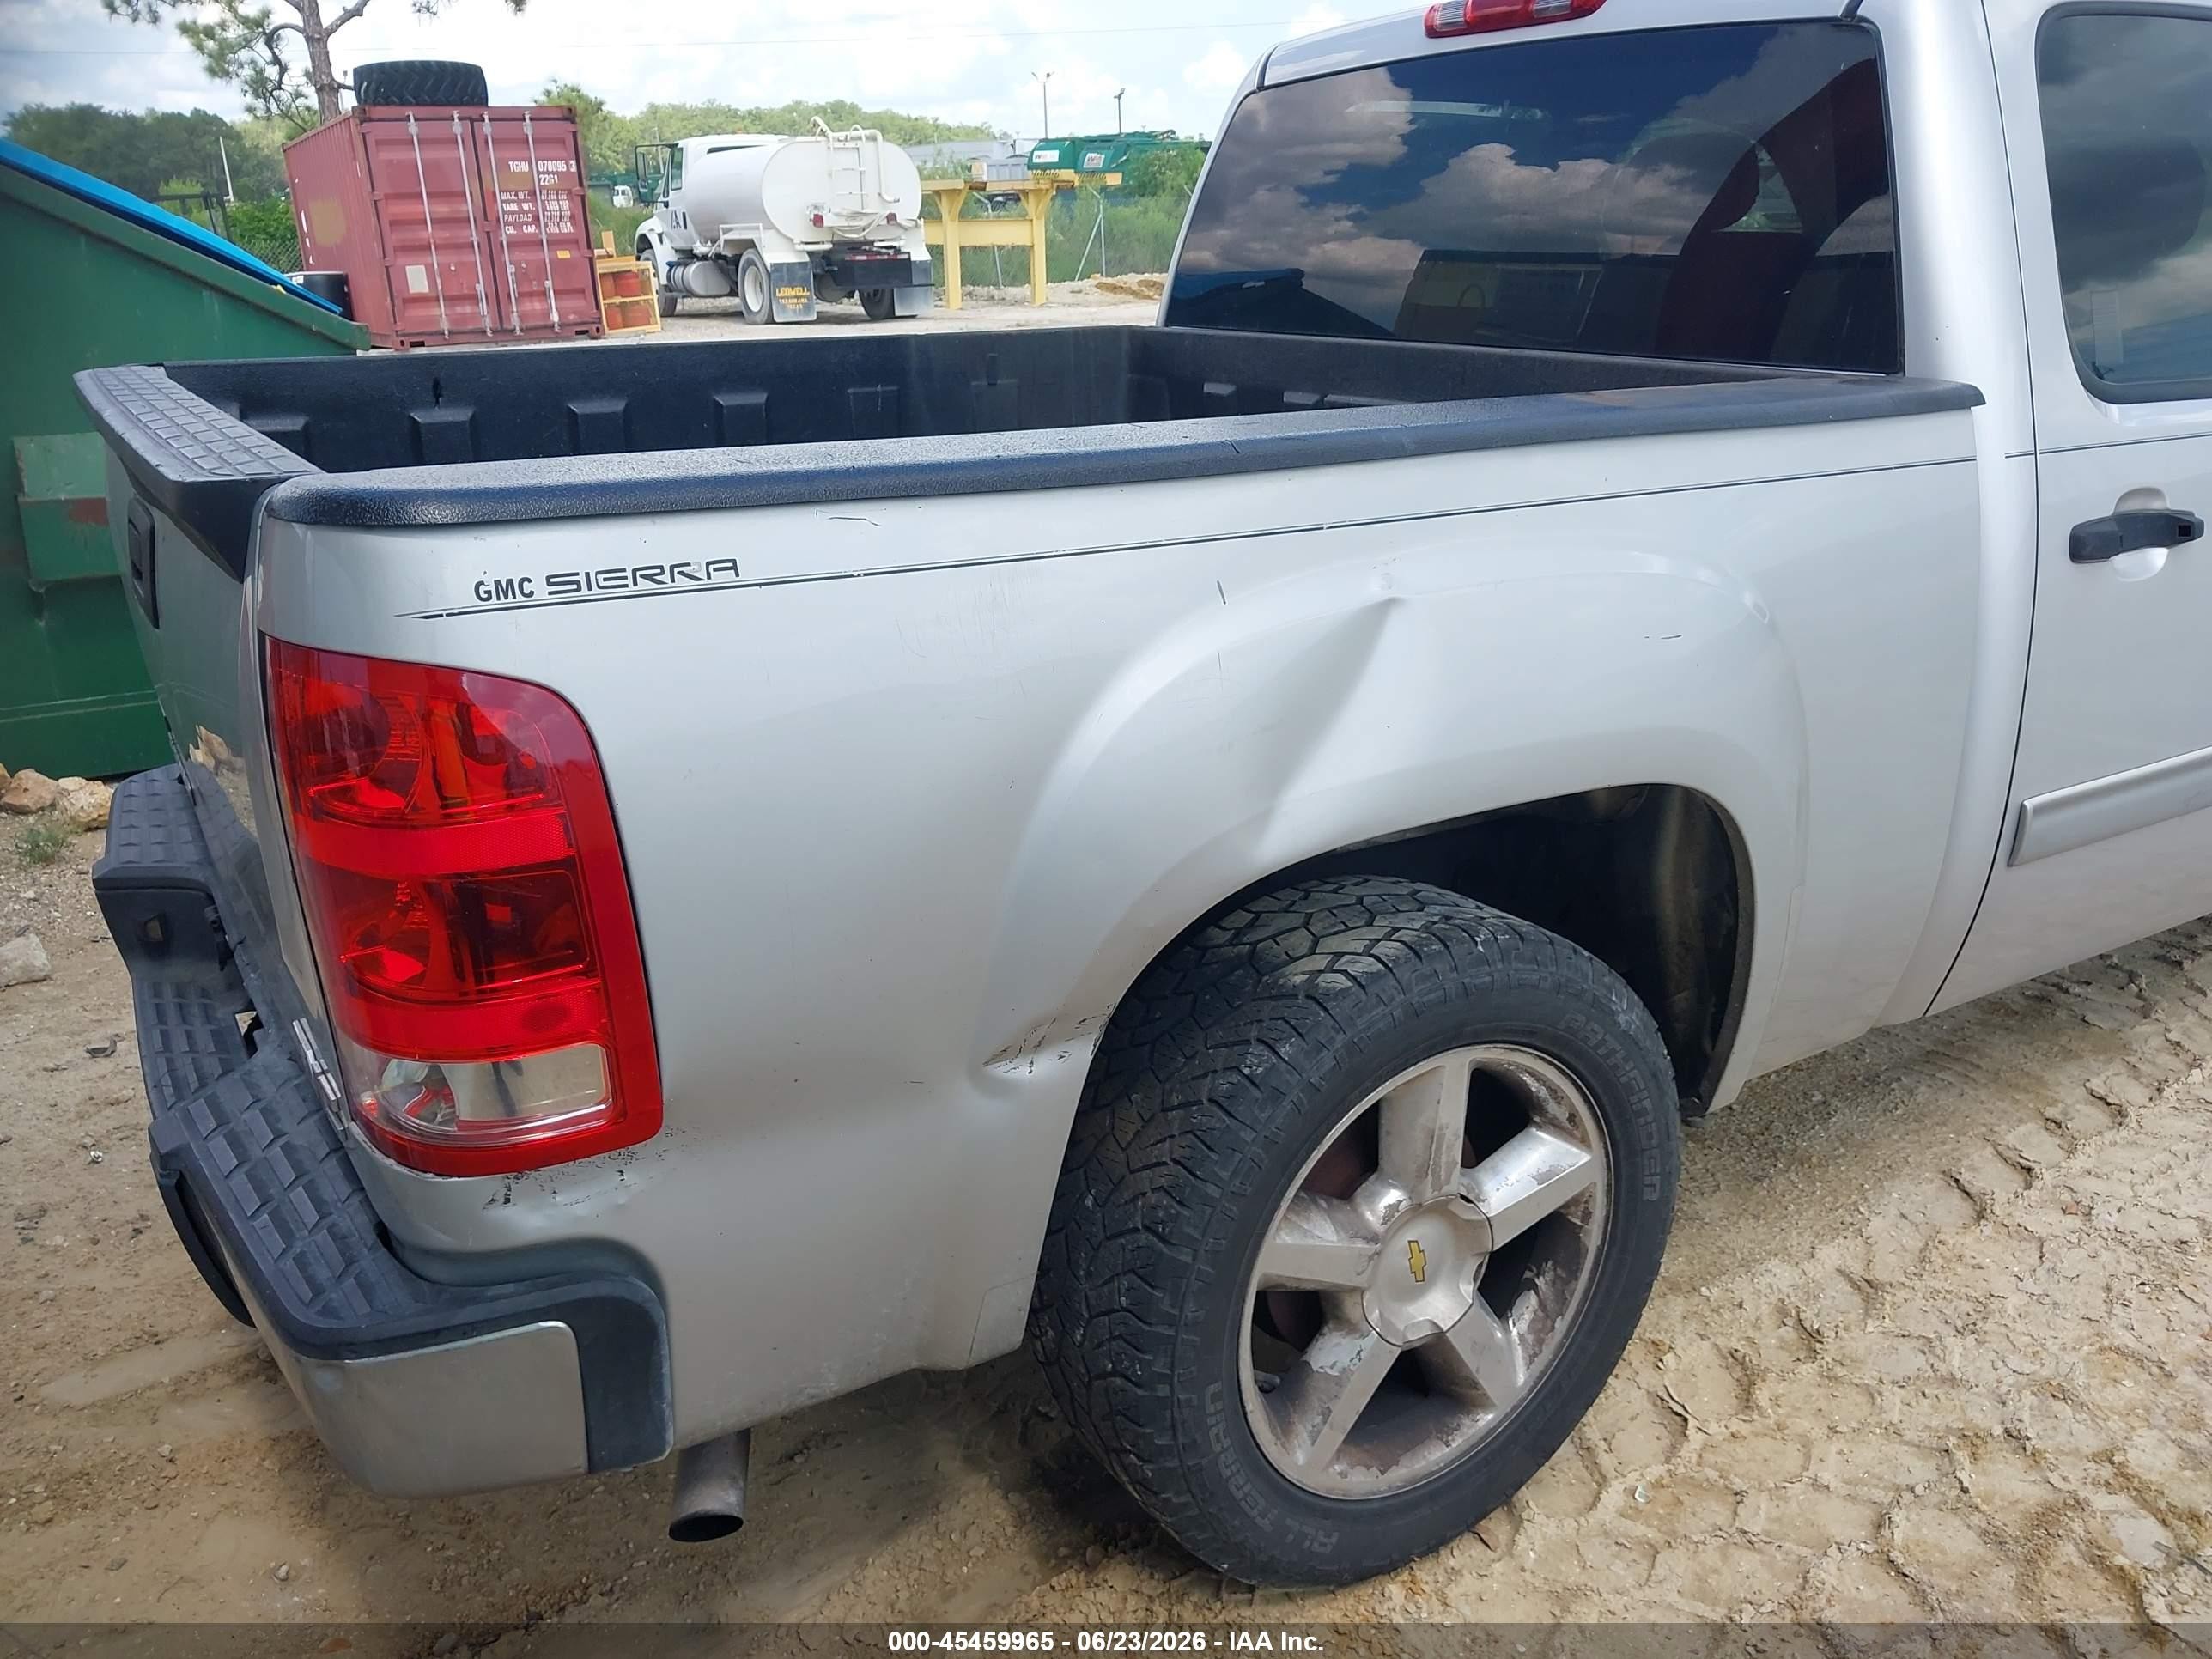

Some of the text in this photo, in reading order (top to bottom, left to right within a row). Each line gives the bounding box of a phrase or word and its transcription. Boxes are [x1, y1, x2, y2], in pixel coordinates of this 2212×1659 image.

[508, 161, 529, 172] TGHU
[538, 161, 567, 172] 070095
[504, 214, 532, 222] PAYLOAD
[474, 558, 740, 602] GMC SIERRA
[1558, 1010, 1661, 1201] PATHFINDER
[1205, 1380, 1340, 1553] ALL TERRAIN
